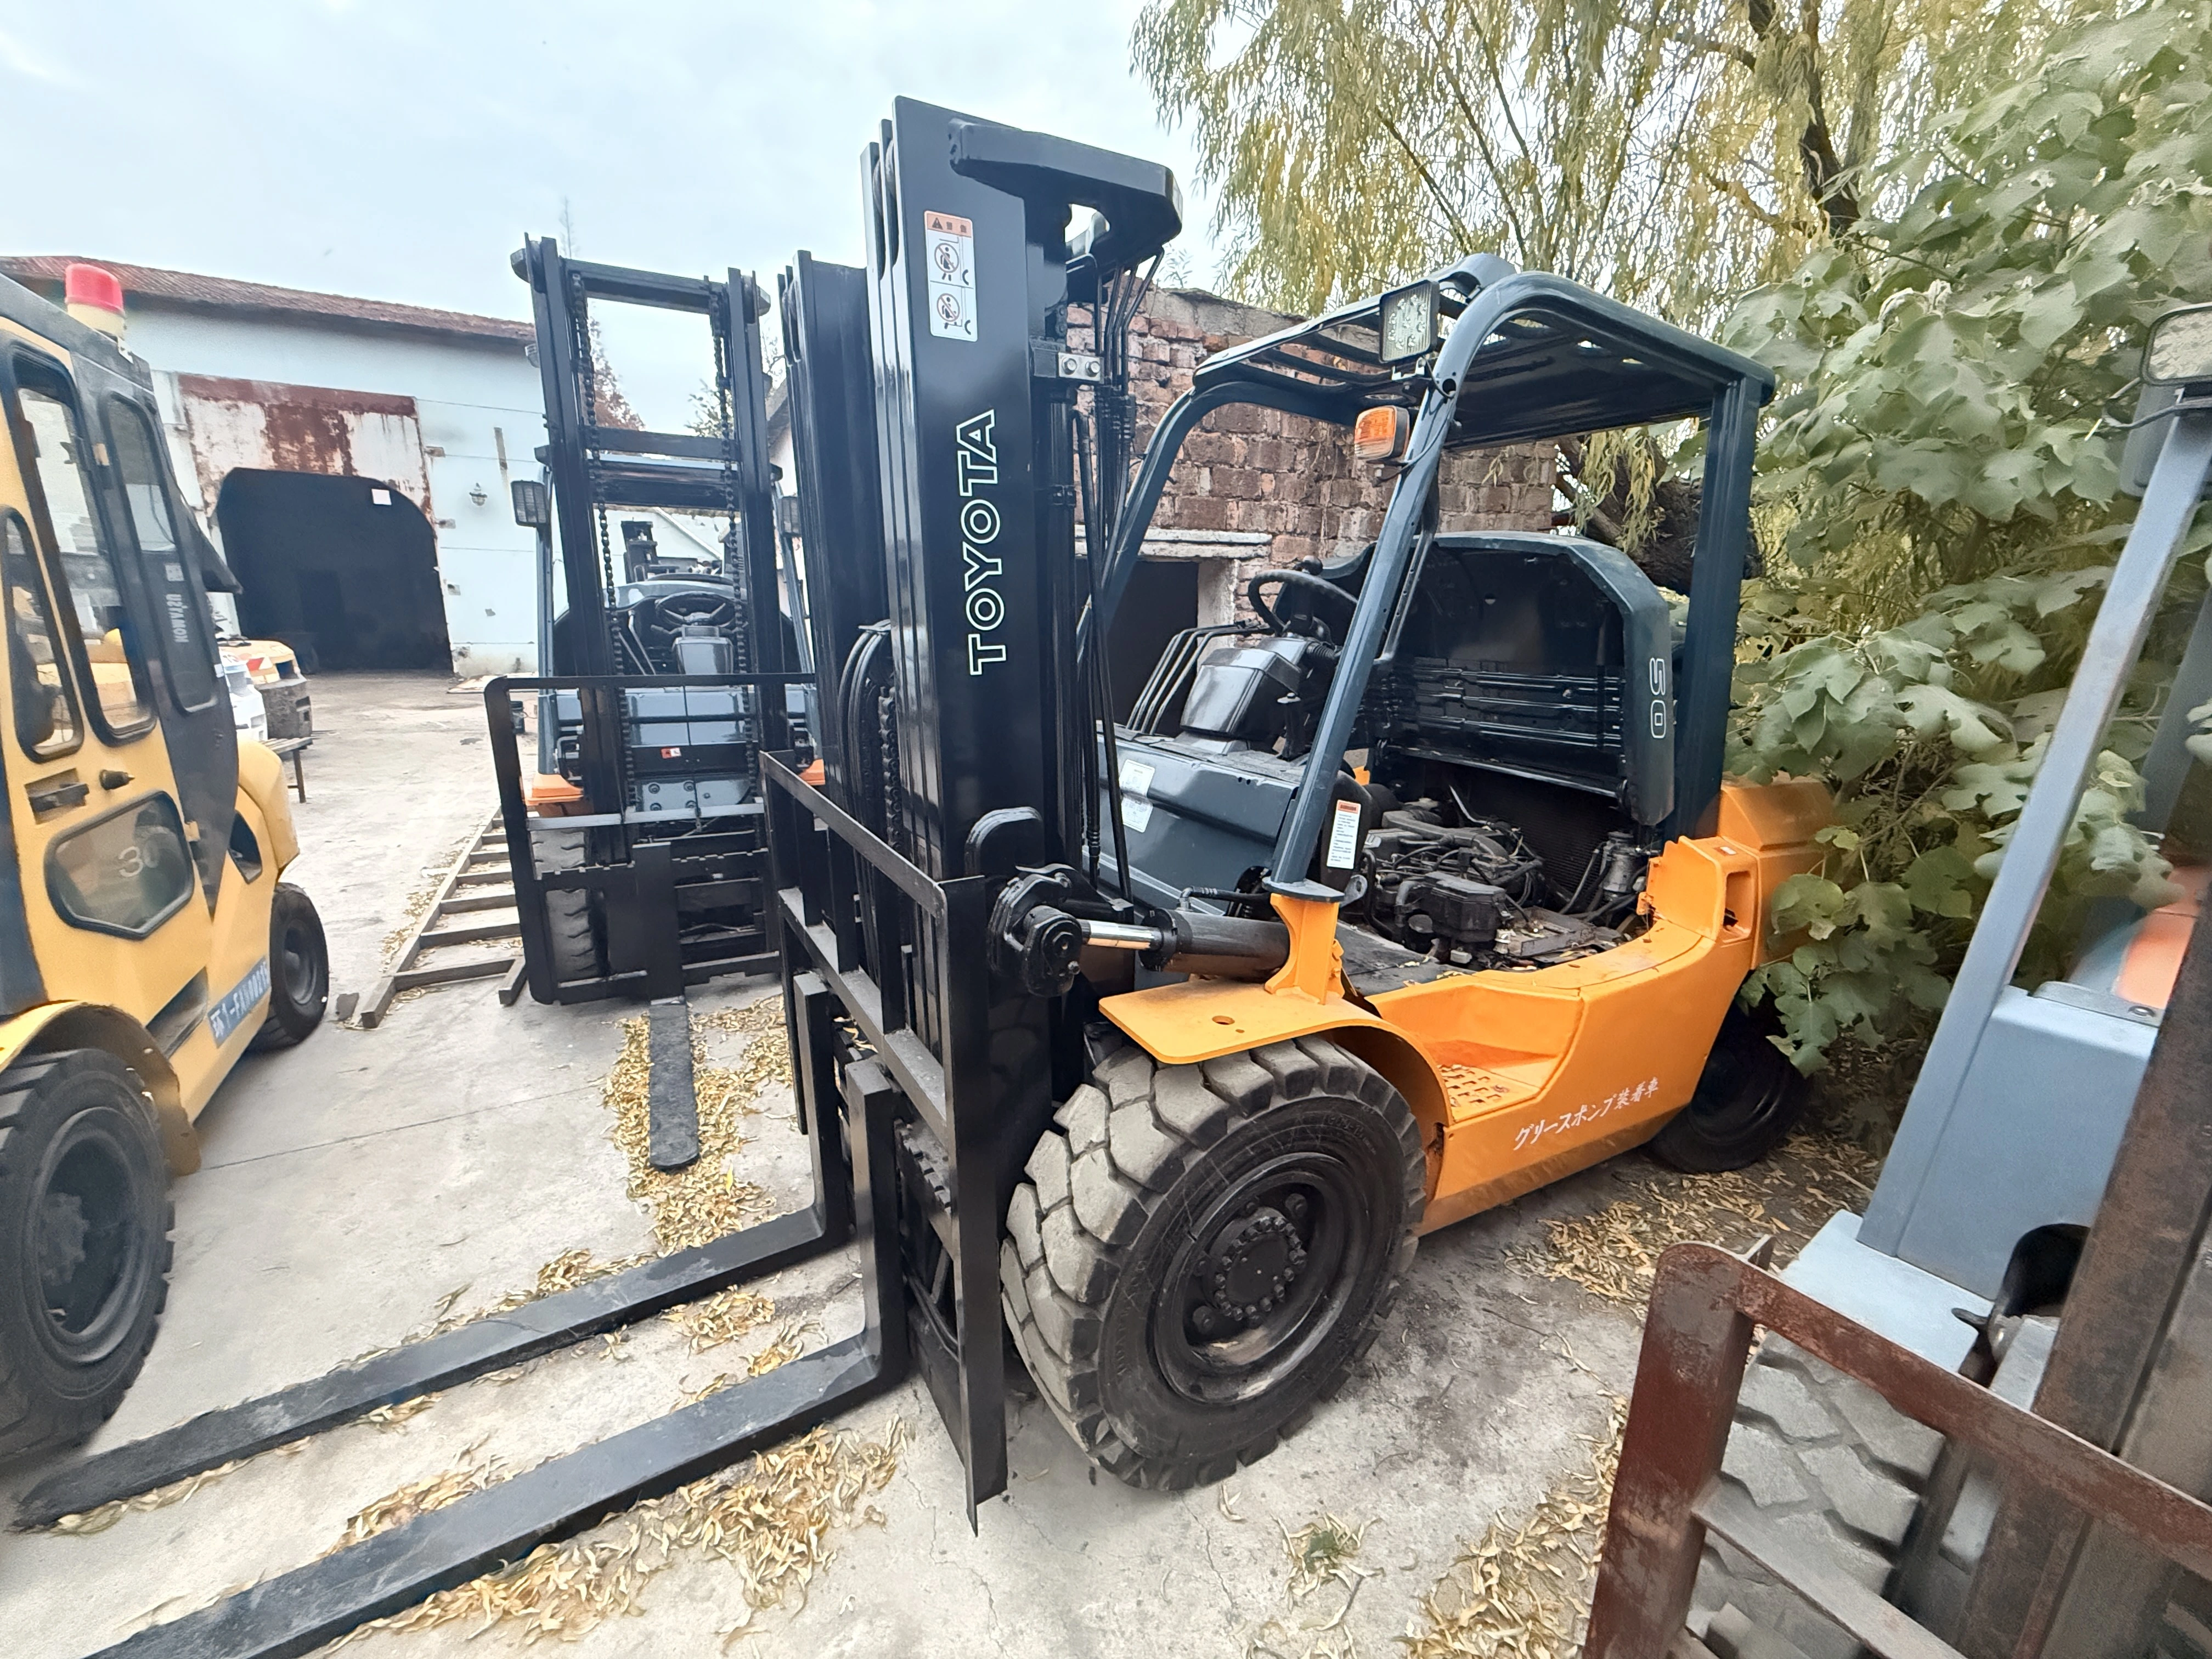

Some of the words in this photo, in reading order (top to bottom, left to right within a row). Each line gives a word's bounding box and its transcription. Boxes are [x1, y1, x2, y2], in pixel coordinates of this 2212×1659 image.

[956, 409, 1007, 676] TOYOTA
[1649, 657, 1666, 739] 50
[1513, 1076, 1659, 1150] グリースポンプ装着車
